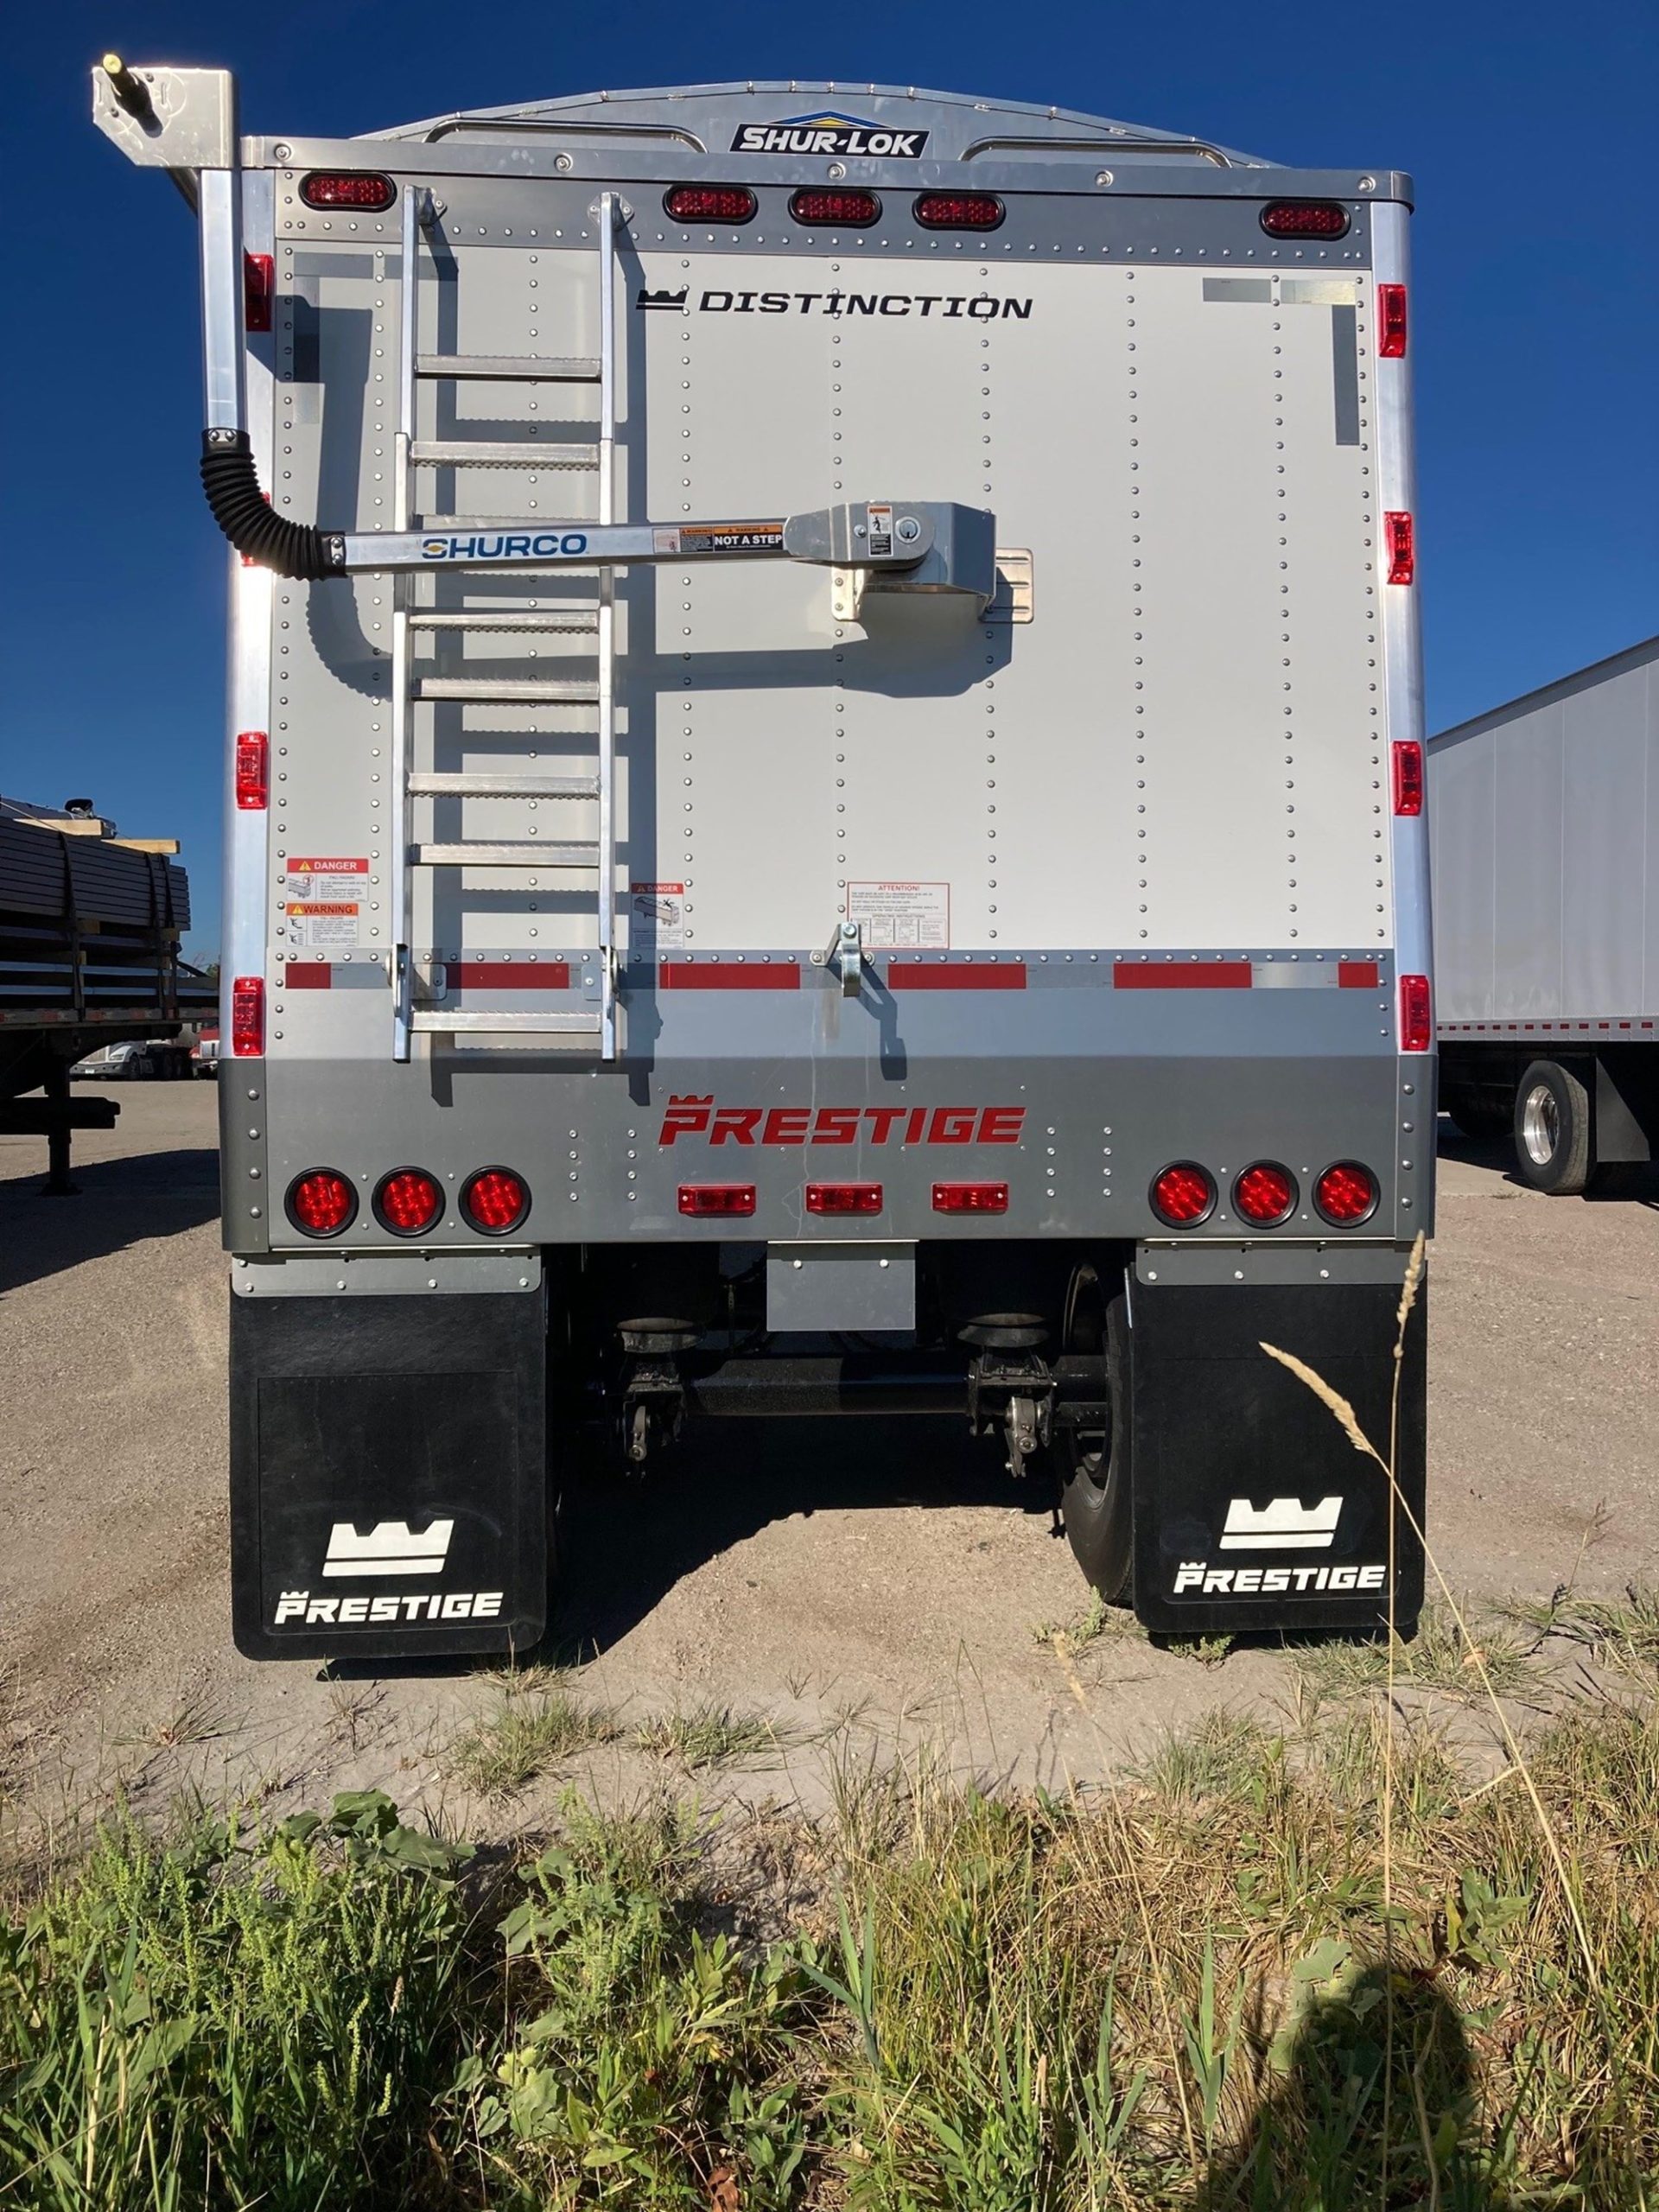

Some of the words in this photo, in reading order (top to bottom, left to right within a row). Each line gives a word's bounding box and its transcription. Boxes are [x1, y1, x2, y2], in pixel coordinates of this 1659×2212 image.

[740, 126, 919, 156] SHUR-LOK
[699, 291, 1033, 319] DISTINCTION
[422, 534, 588, 560] SHURCO
[715, 535, 739, 546] NOT
[741, 535, 750, 545] A
[752, 534, 783, 544] STEP
[314, 861, 358, 870] DANGER
[303, 905, 353, 914] WARNING
[658, 1106, 1027, 1146] PRESTIGE
[1173, 1564, 1387, 1593] PRESTIGE
[274, 1592, 504, 1624] PRESTIGE
